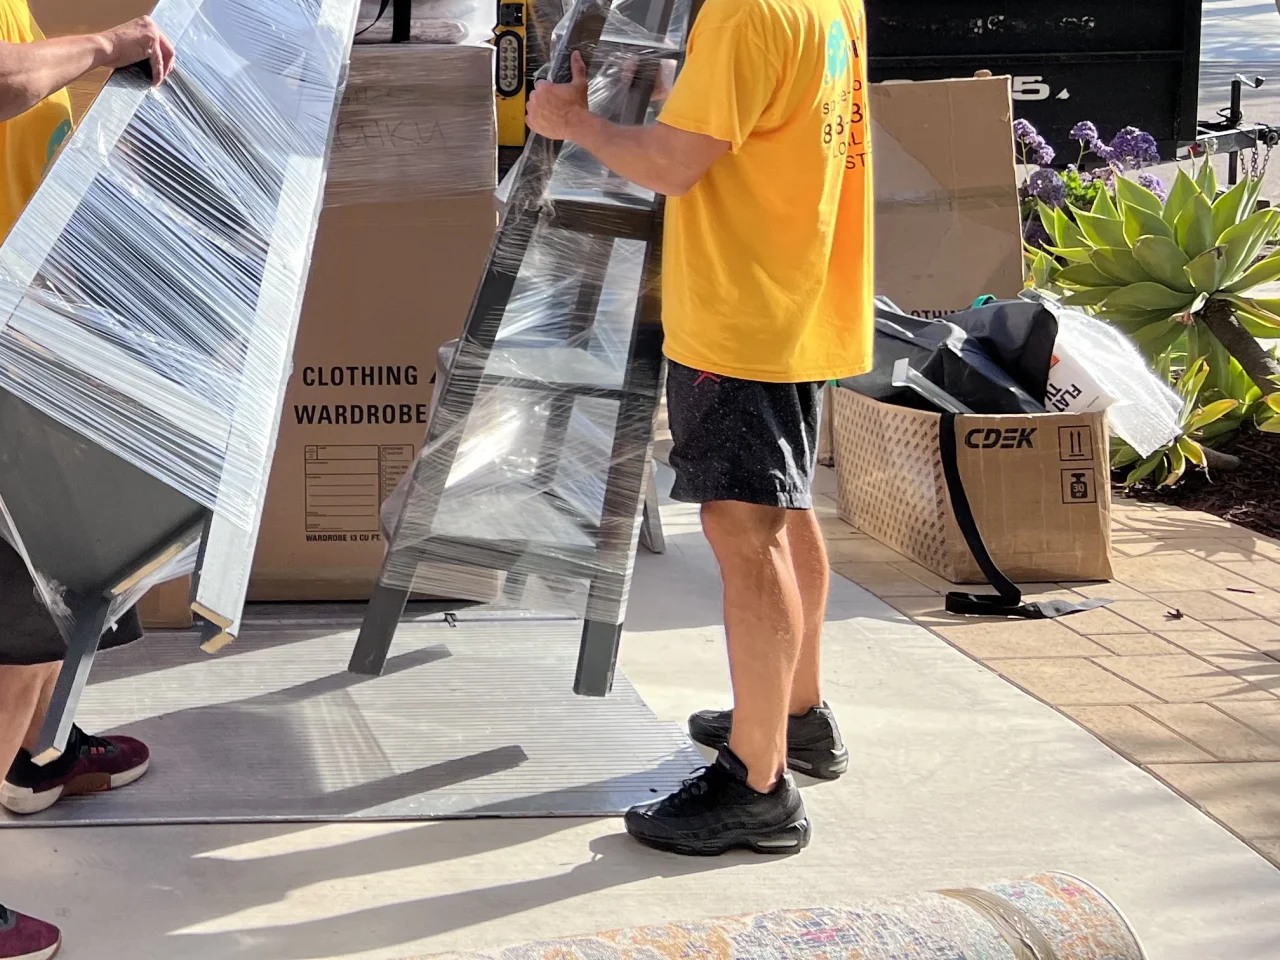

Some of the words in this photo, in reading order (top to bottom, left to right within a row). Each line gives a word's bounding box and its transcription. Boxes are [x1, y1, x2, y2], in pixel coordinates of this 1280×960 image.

[302, 365, 419, 387] CLOTHING
[294, 403, 427, 425] WARDROBE
[964, 427, 1038, 449] CDEK
[1072, 483, 1085, 492] 30
[306, 534, 347, 542] WARDROBE
[359, 534, 369, 542] CU
